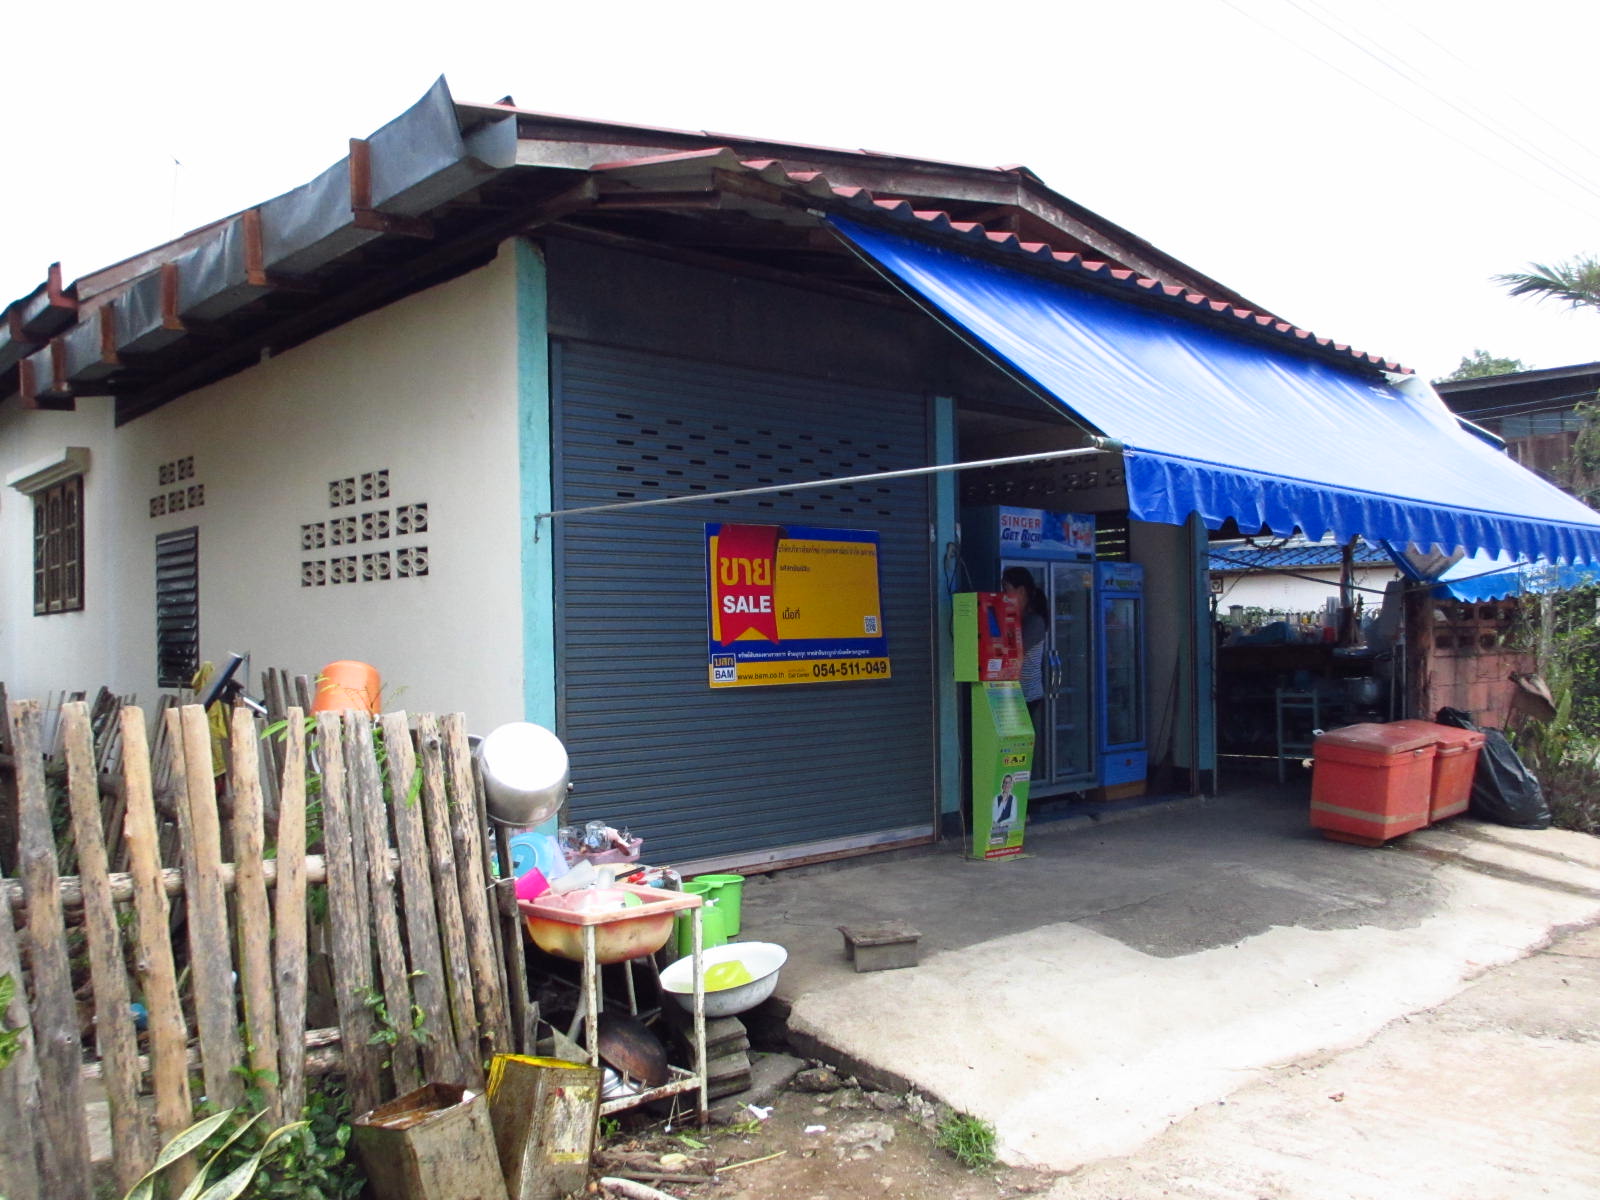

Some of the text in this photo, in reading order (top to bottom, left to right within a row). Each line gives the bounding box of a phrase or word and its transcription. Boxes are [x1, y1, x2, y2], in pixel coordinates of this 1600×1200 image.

[1001, 514, 1040, 529] SINGER
[1002, 527, 1041, 543] GET RICH
[720, 556, 772, 586] ขาย
[723, 595, 772, 614] SALE
[714, 669, 734, 680] BAM
[813, 661, 887, 678] 054-511-049
